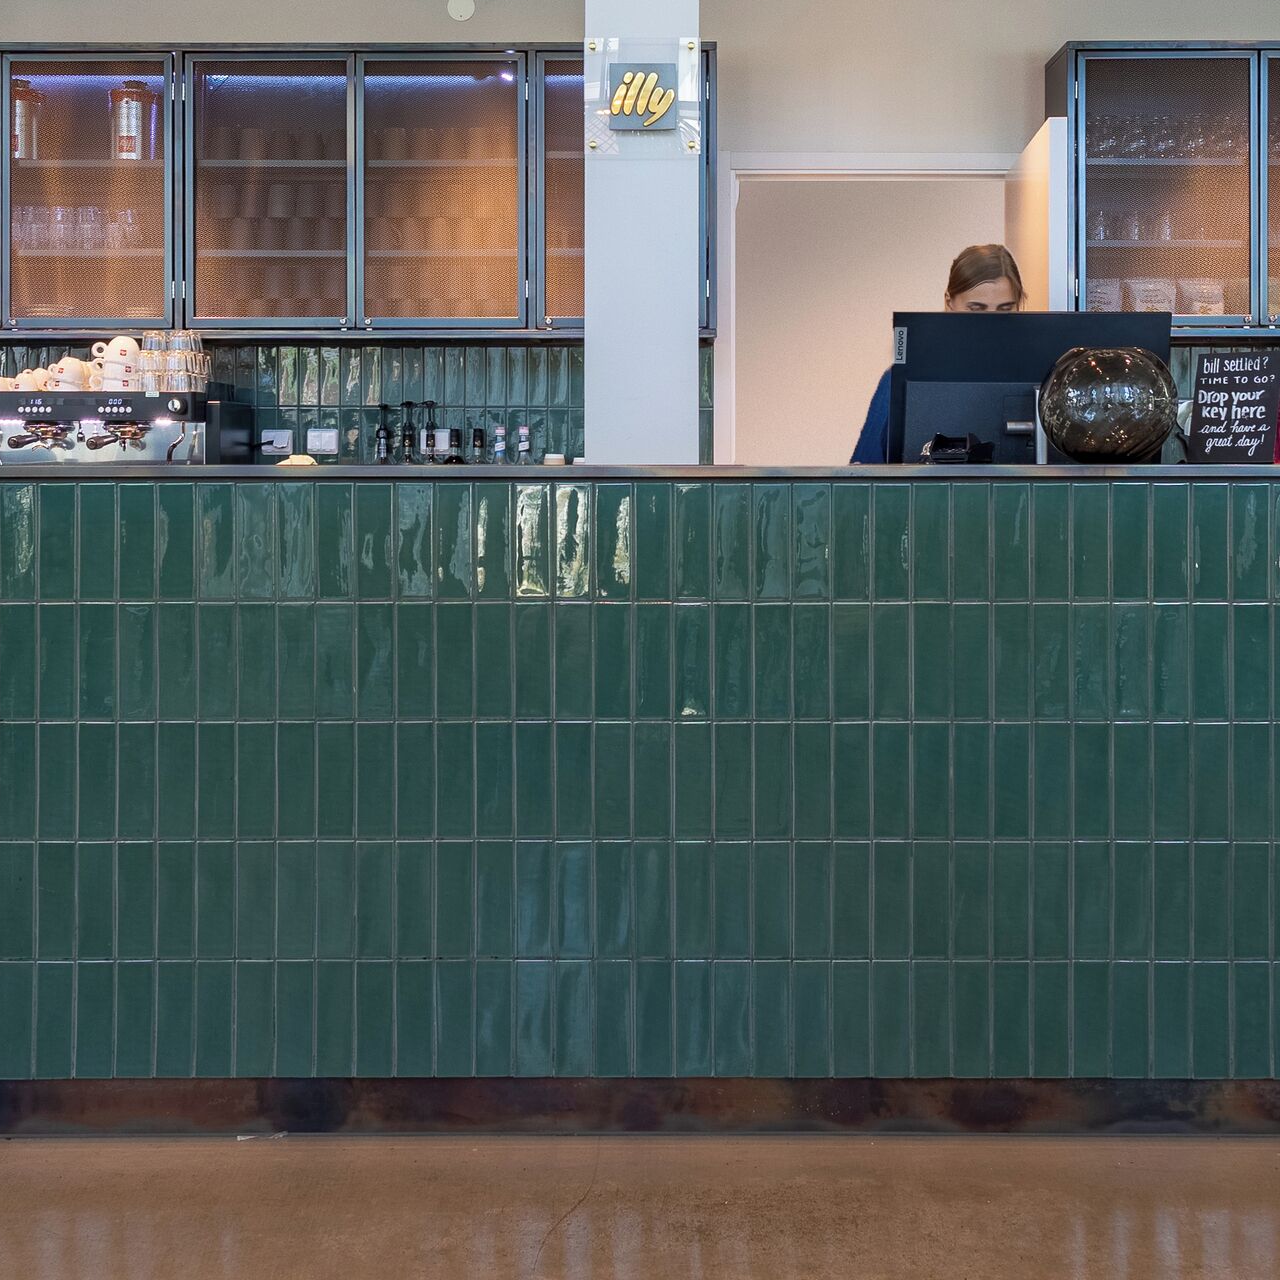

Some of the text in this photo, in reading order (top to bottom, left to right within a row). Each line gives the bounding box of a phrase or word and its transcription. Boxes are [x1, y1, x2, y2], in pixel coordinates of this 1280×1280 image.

[610, 71, 676, 128] illy
[896, 330, 904, 361] Lenovo
[1203, 357, 1220, 374] bill
[1200, 376, 1229, 385] TIME
[1233, 376, 1248, 384] TO
[1198, 389, 1266, 406] Drop your
[1231, 405, 1266, 419] here
[1198, 420, 1271, 434] and have a
[1205, 434, 1265, 456] great day!
